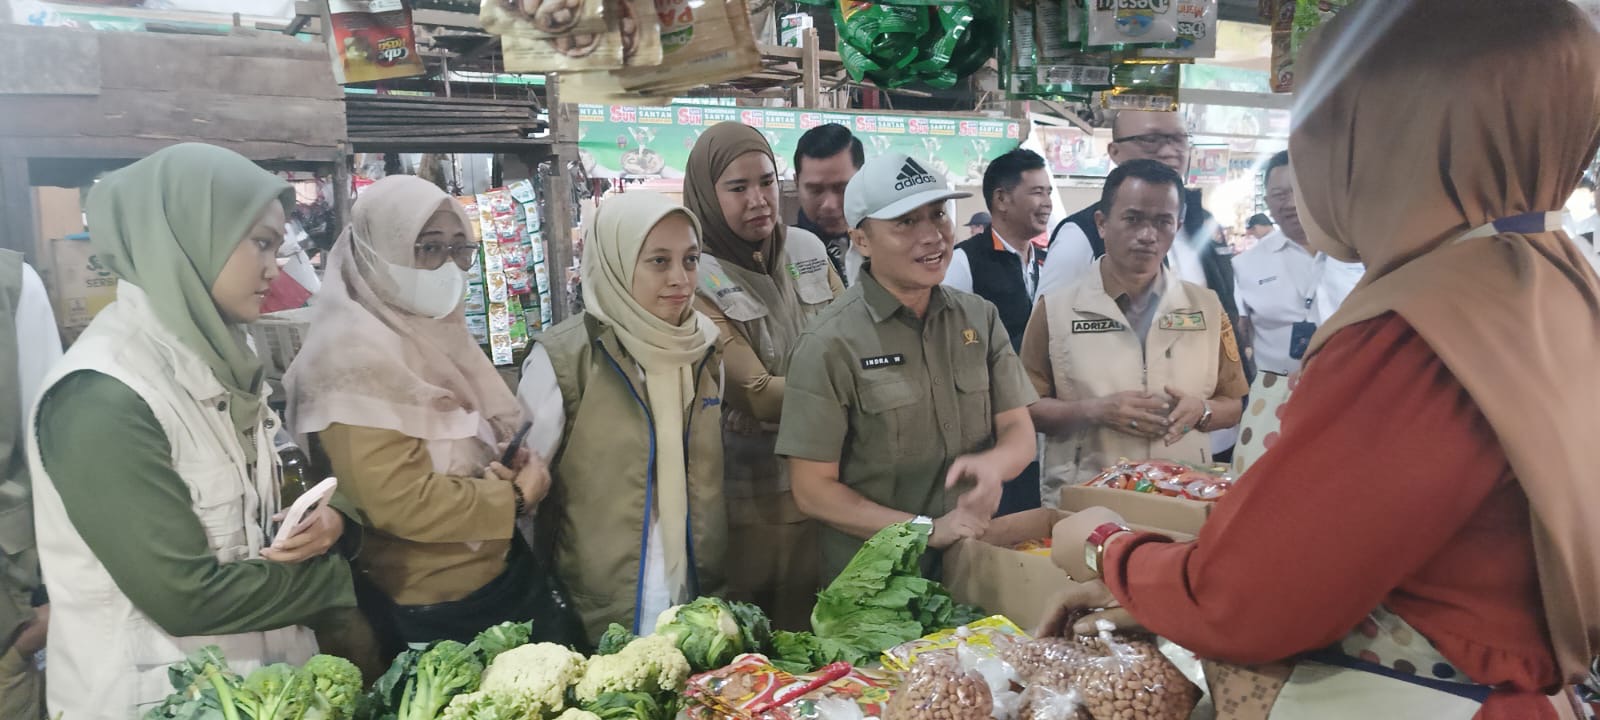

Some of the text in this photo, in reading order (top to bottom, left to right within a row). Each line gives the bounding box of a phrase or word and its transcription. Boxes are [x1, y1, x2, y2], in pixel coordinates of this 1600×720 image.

[638, 110, 672, 119] SANTAN
[895, 175, 936, 190] adidas
[865, 358, 889, 366] INDRA
